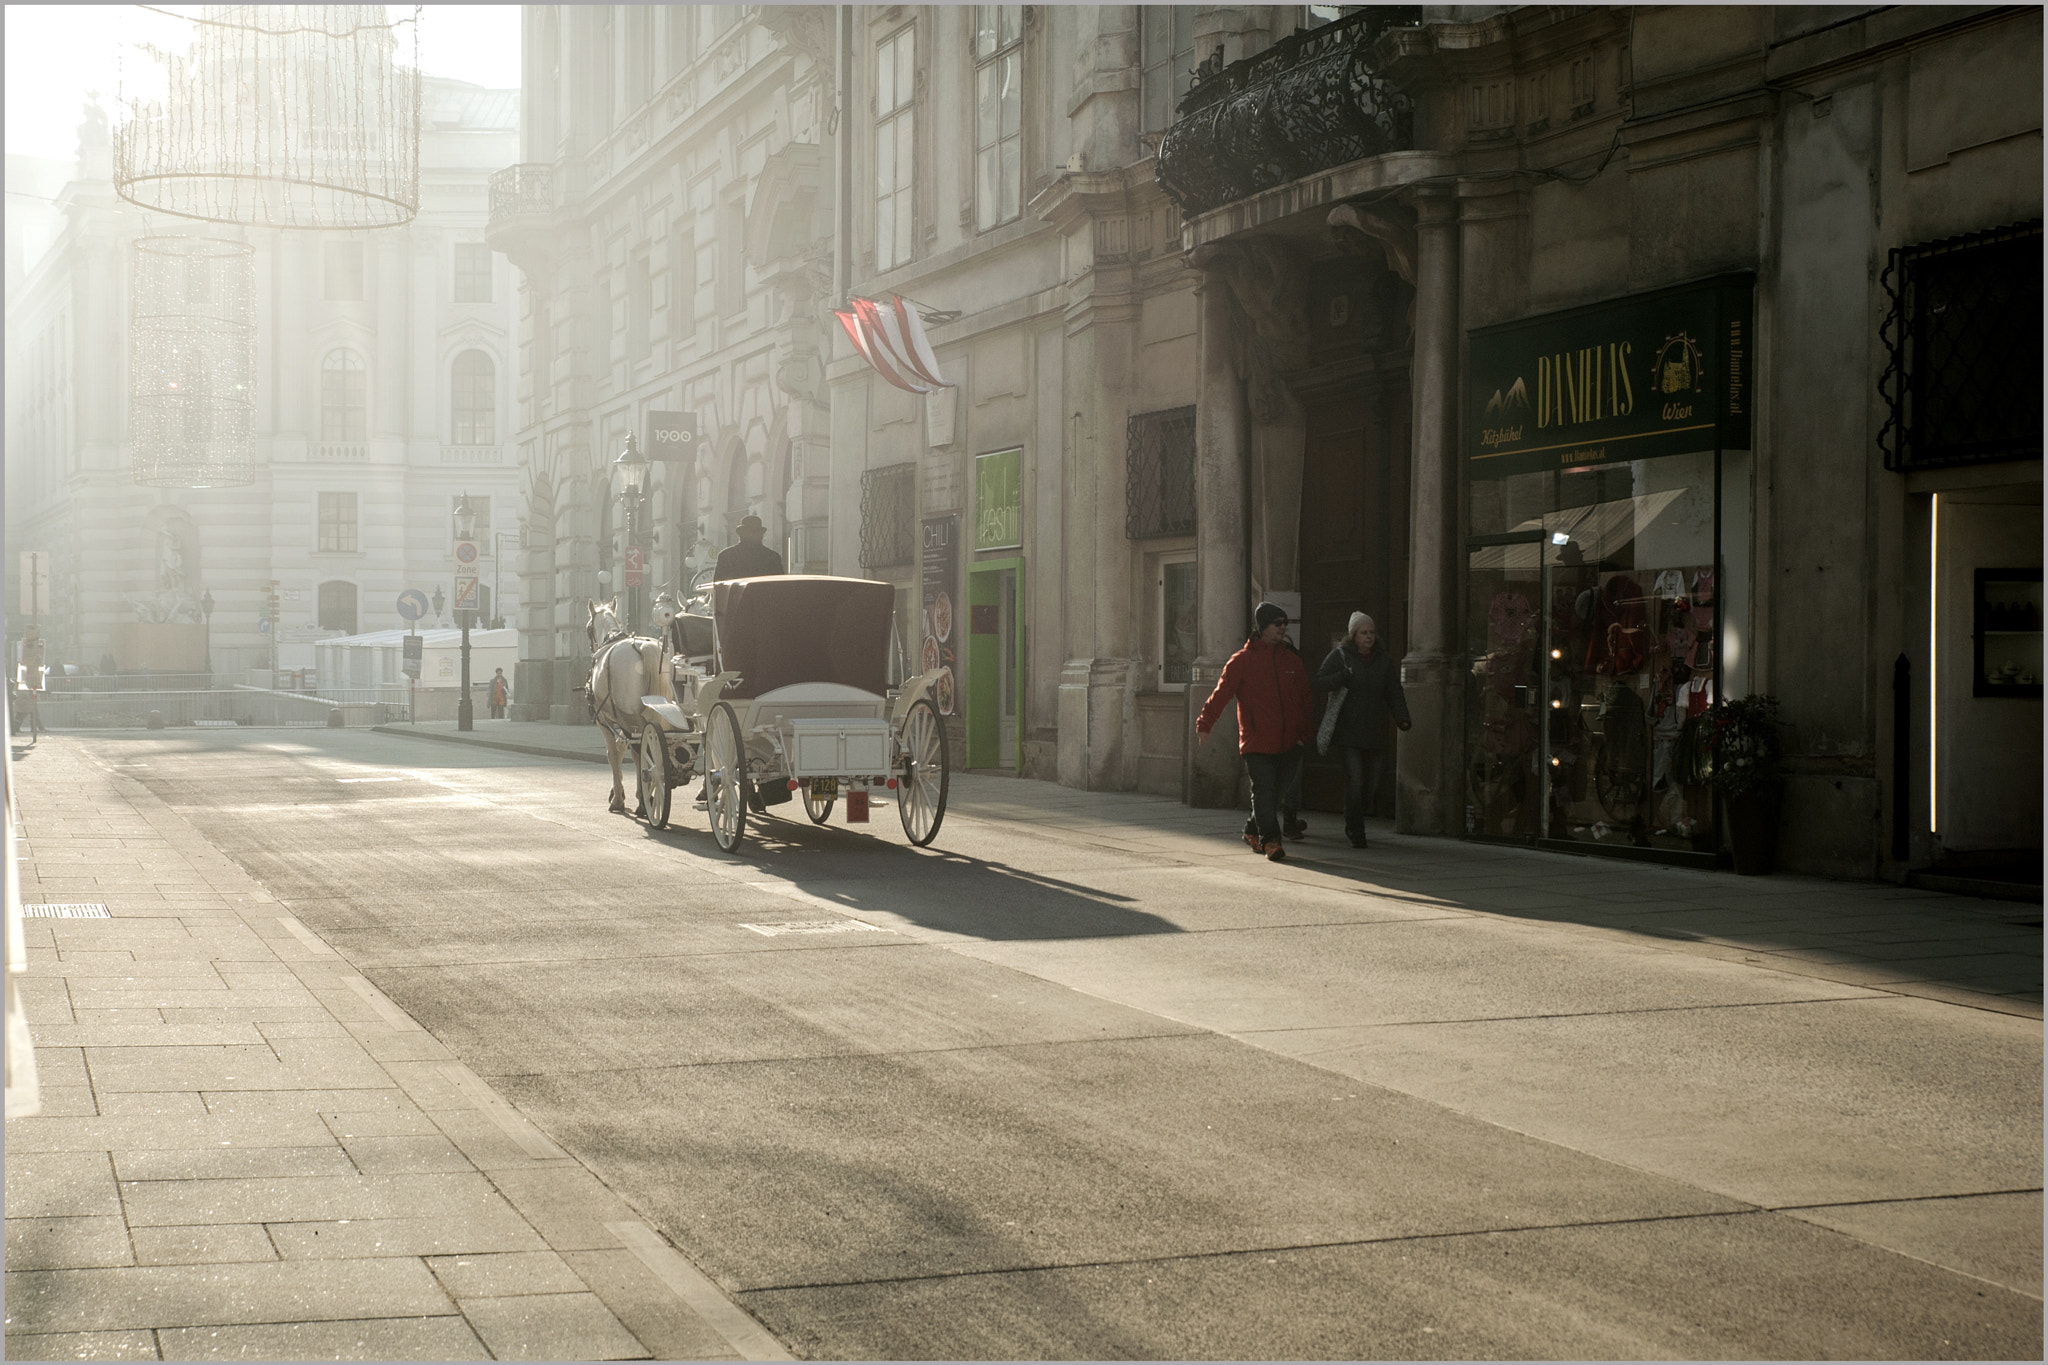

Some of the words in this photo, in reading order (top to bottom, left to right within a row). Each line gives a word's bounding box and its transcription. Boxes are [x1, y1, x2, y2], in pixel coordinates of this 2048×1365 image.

[1537, 340, 1634, 429] DANIELAS
[1662, 402, 1693, 421] Wien
[654, 428, 692, 444] 1900
[1480, 424, 1524, 449] Kitzbühel
[456, 564, 477, 574] Zone
